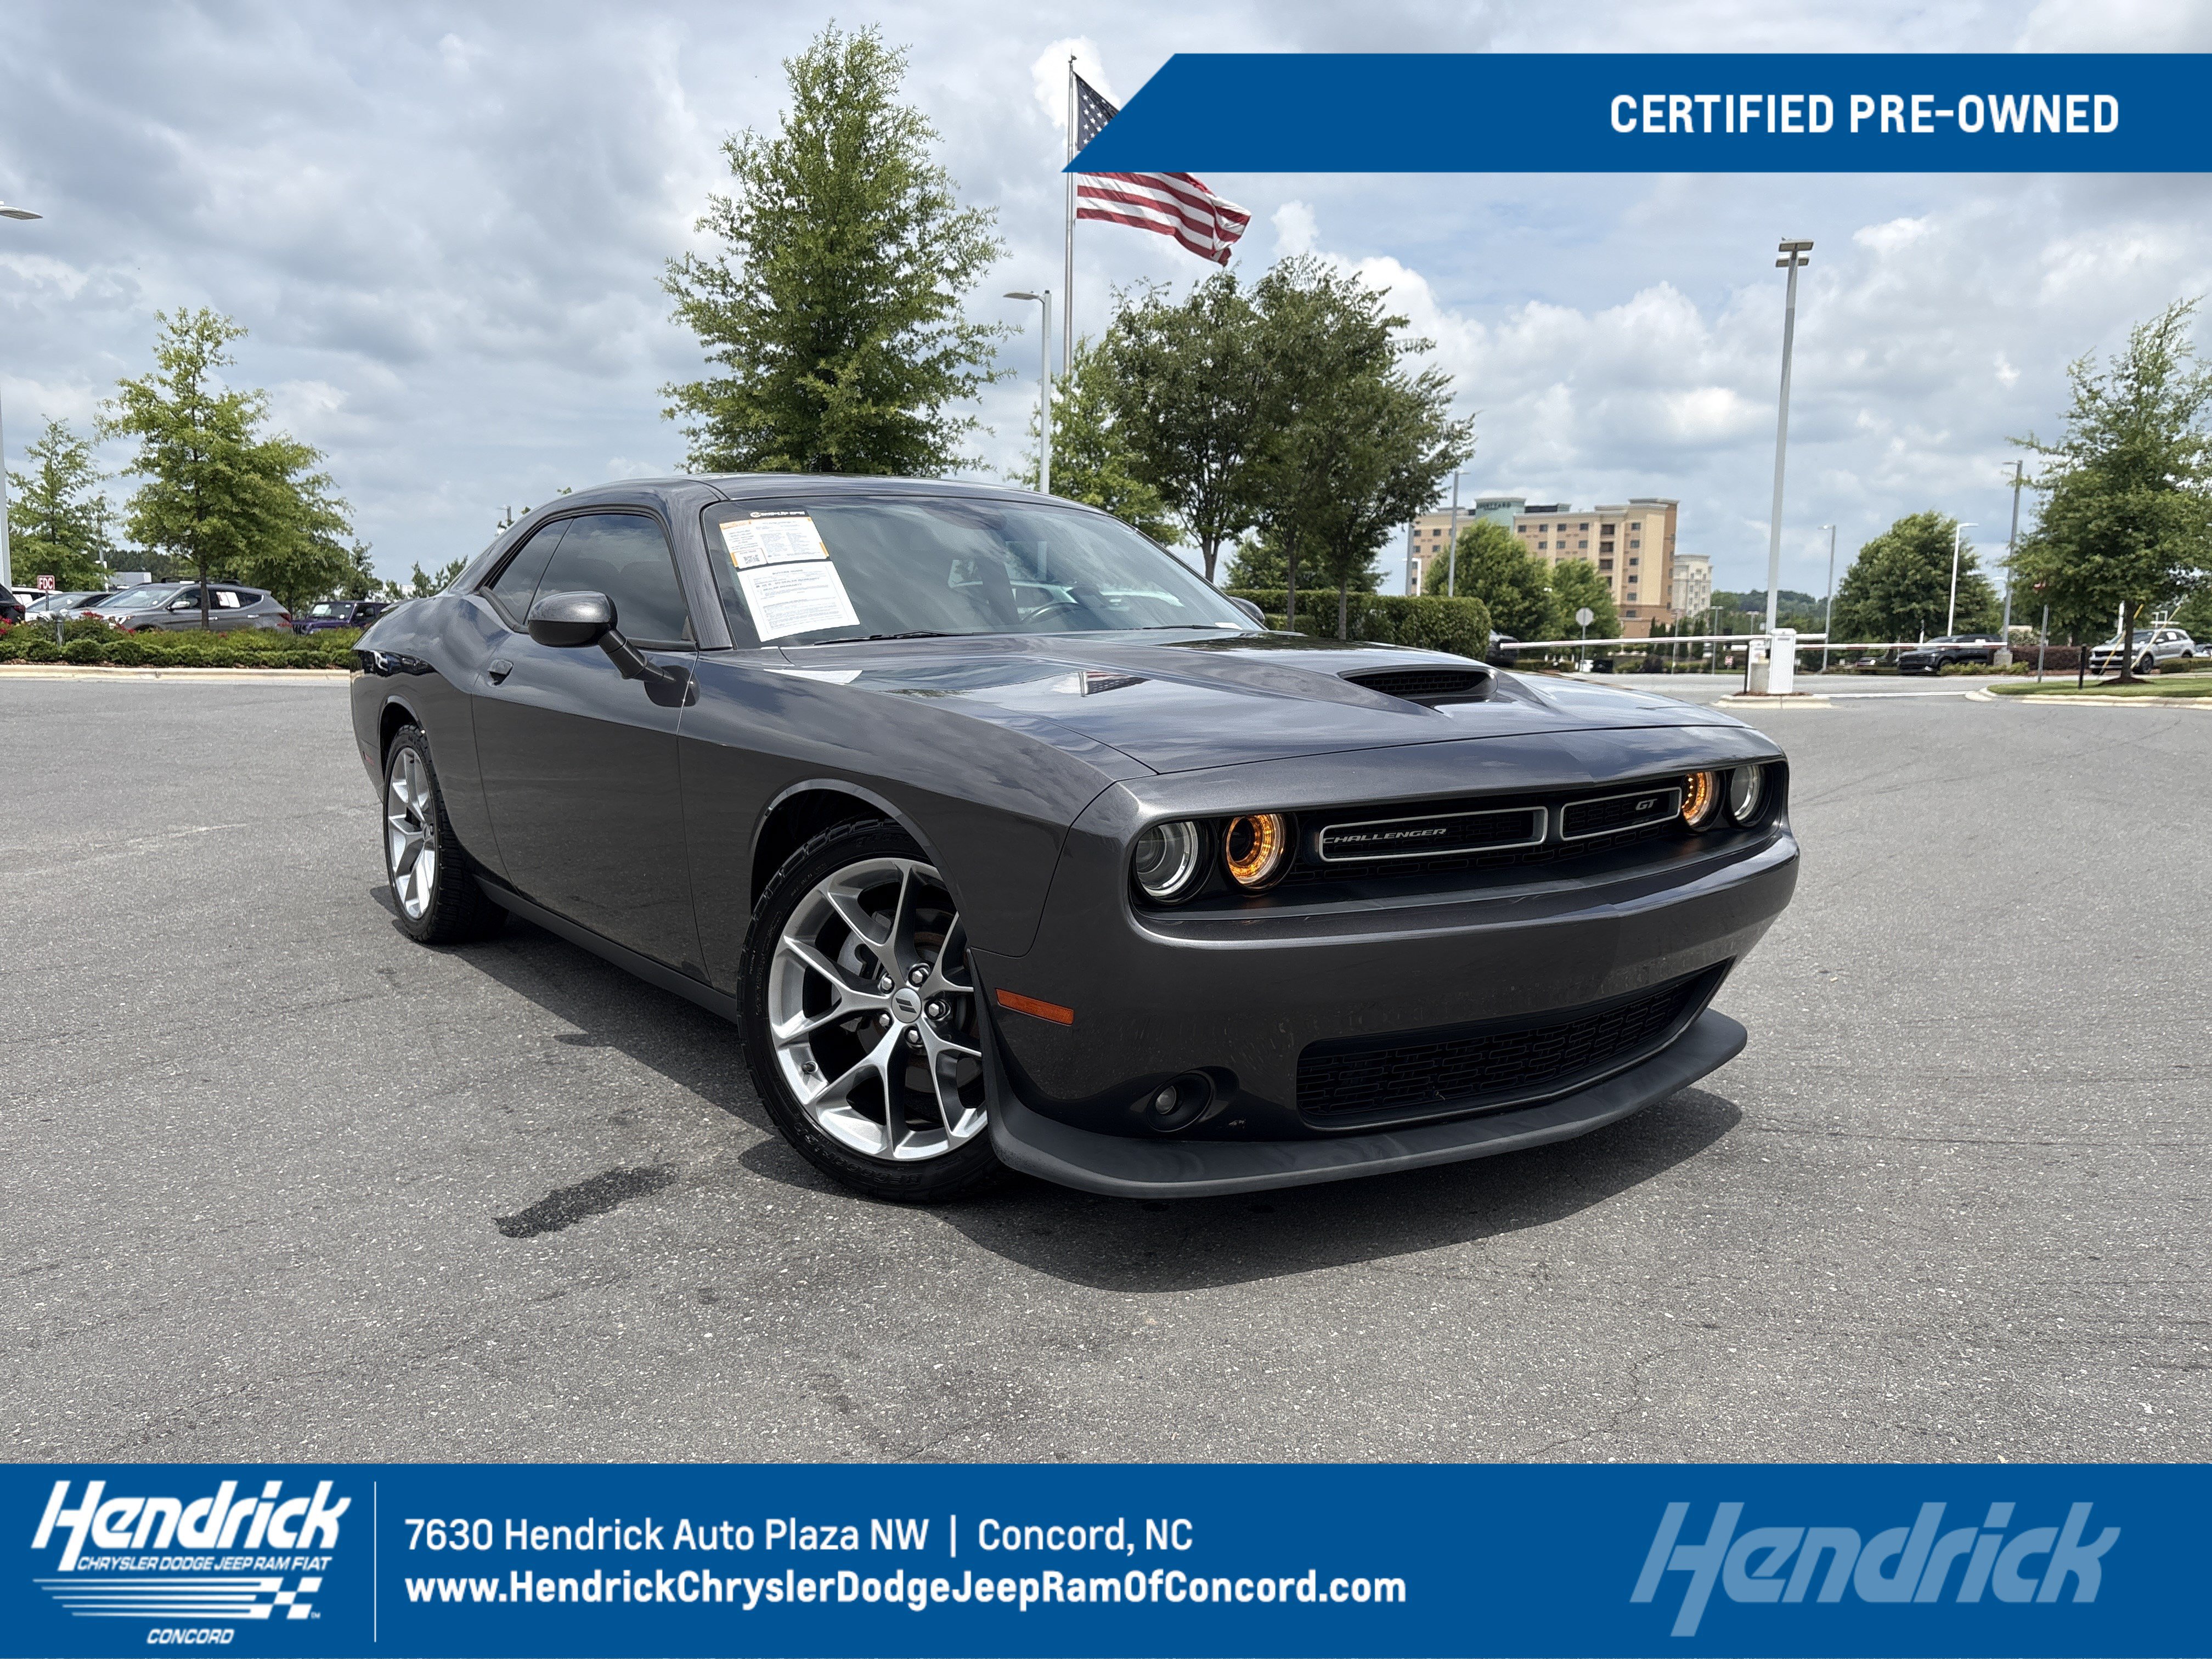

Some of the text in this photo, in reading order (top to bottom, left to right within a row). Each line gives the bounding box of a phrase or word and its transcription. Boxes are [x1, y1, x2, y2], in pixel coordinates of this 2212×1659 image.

[39, 577, 53, 589] FDC
[1635, 798, 1658, 811] GT
[1323, 828, 1447, 844] CHALLENGER
